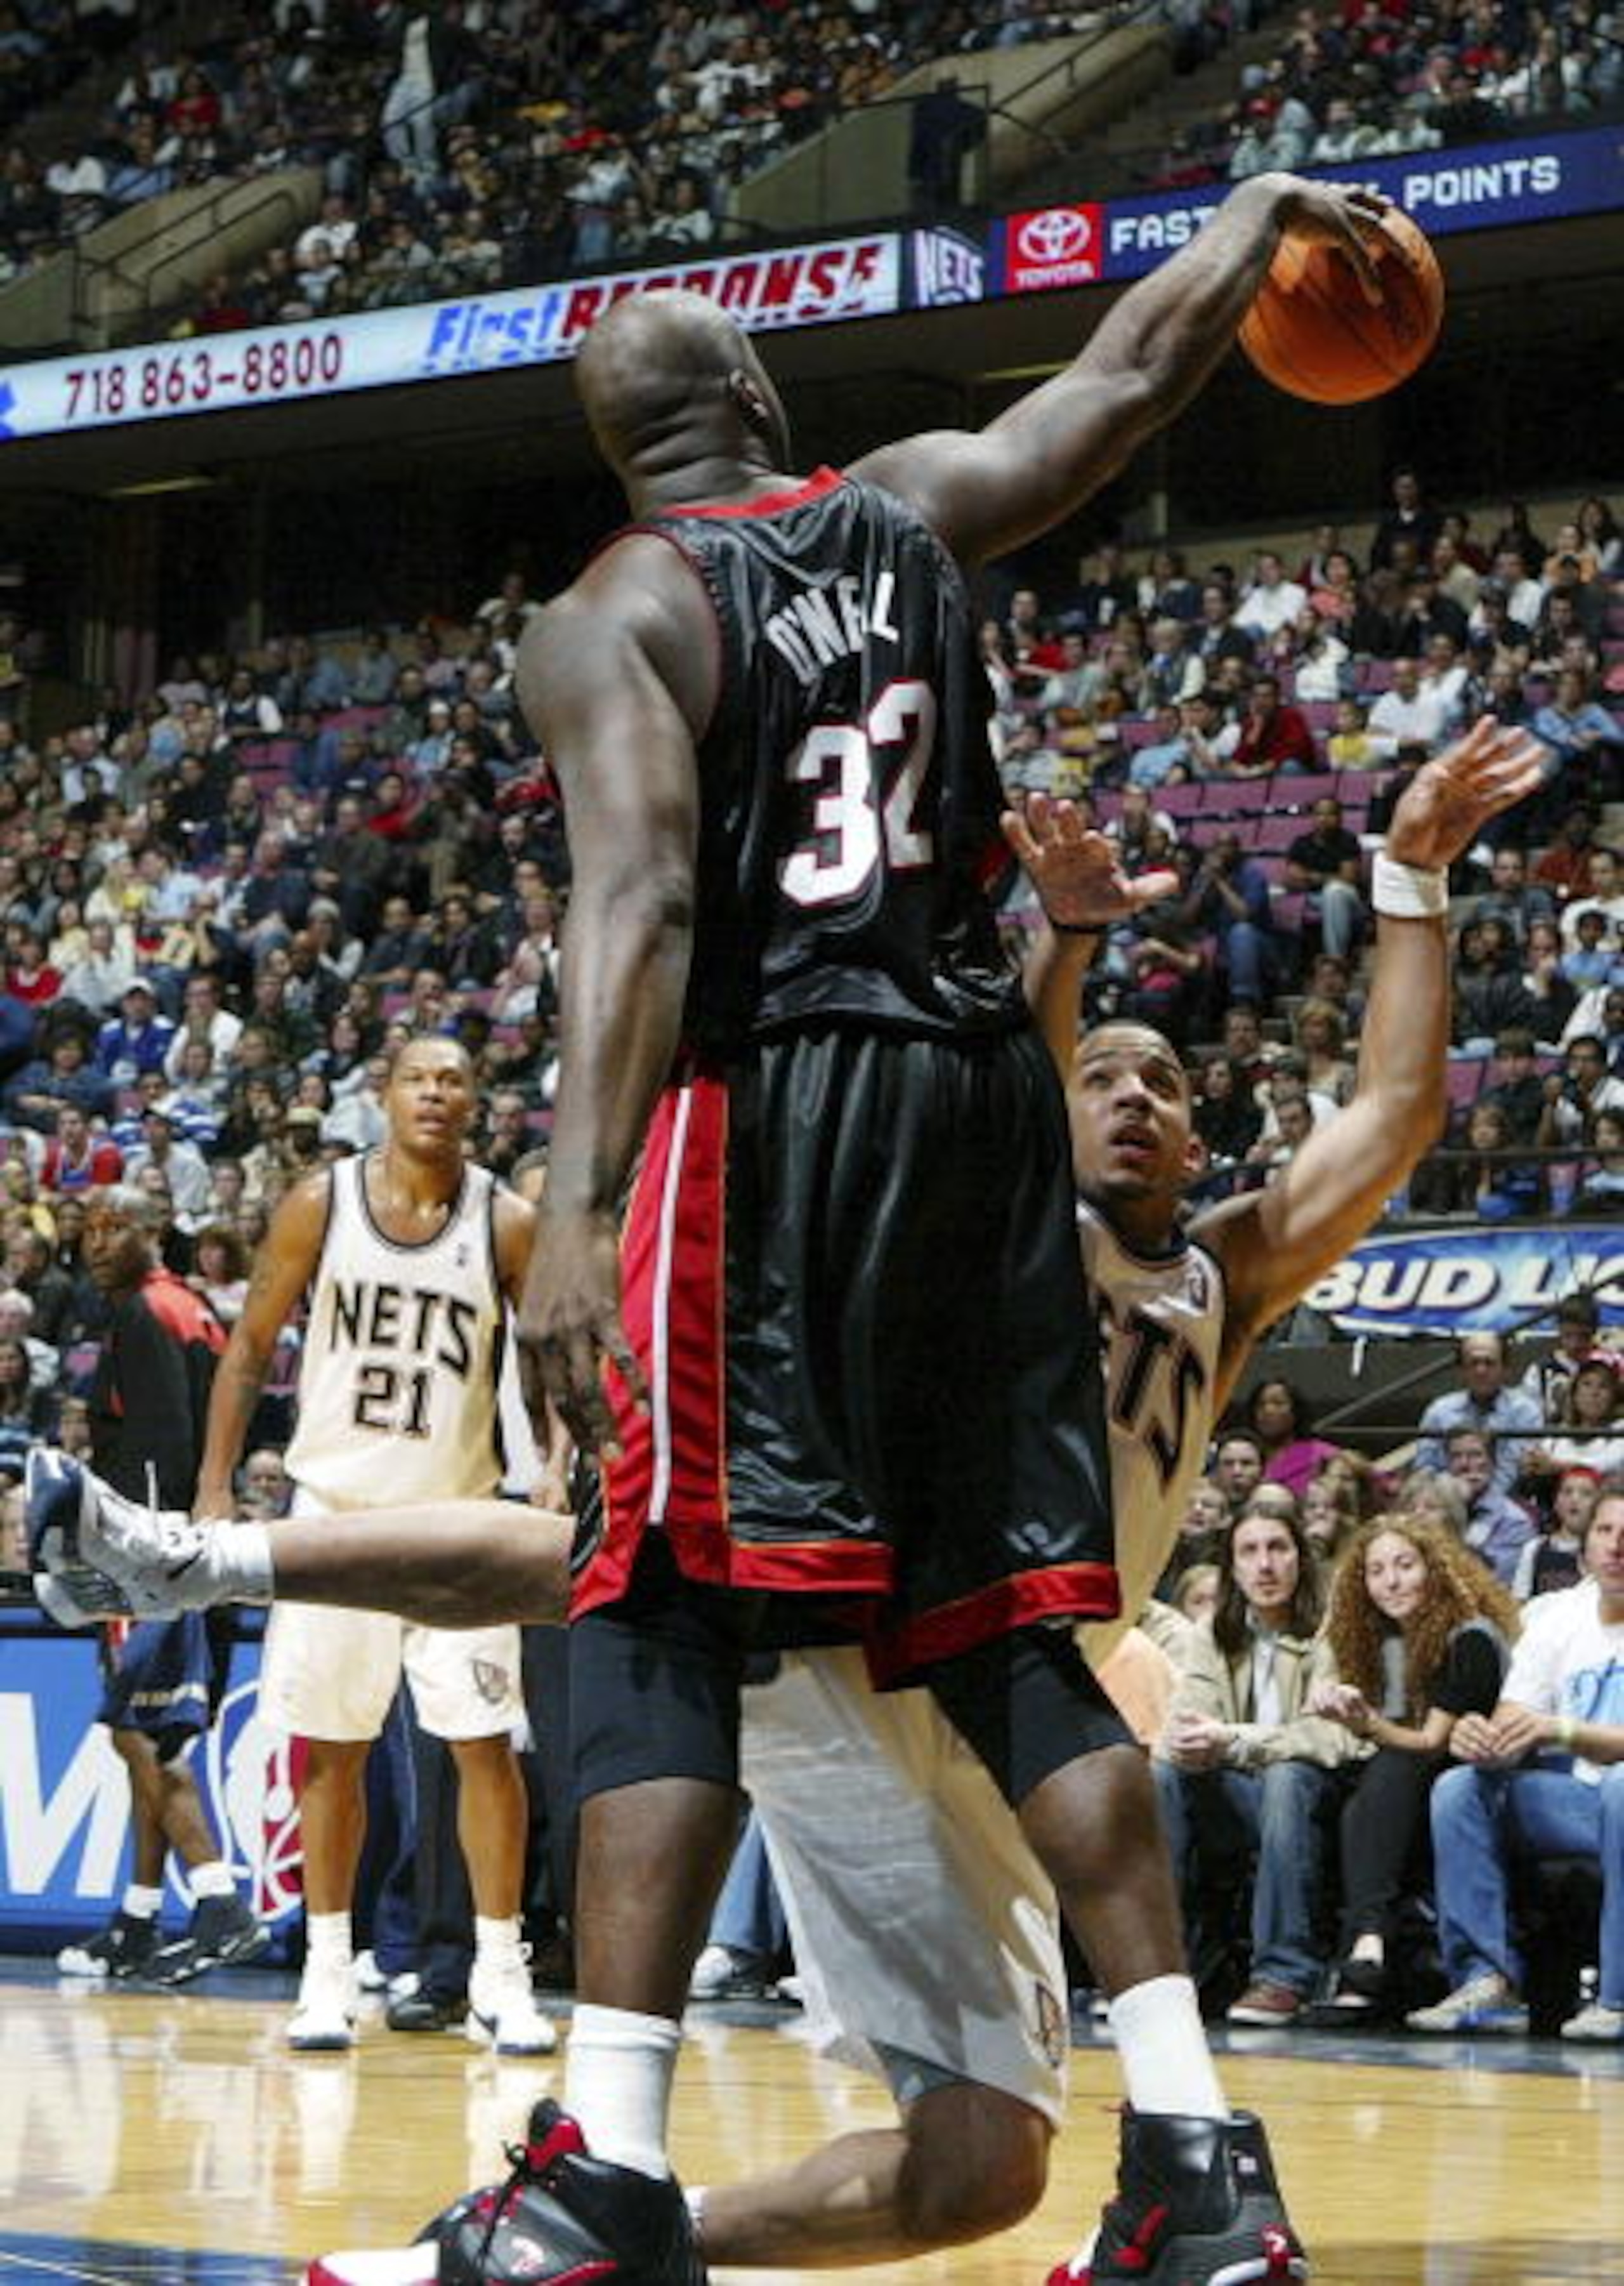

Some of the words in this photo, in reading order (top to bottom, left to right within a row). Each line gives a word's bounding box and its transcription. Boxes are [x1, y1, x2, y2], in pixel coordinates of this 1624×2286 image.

[1404, 156, 1561, 210] POINTS
[64, 364, 126, 421] 718
[141, 333, 343, 409] 863-8800
[778, 676, 938, 909] 32
[1302, 1255, 1500, 1312] BUD
[329, 1278, 477, 1387] NETS
[353, 1365, 432, 1439] 21
